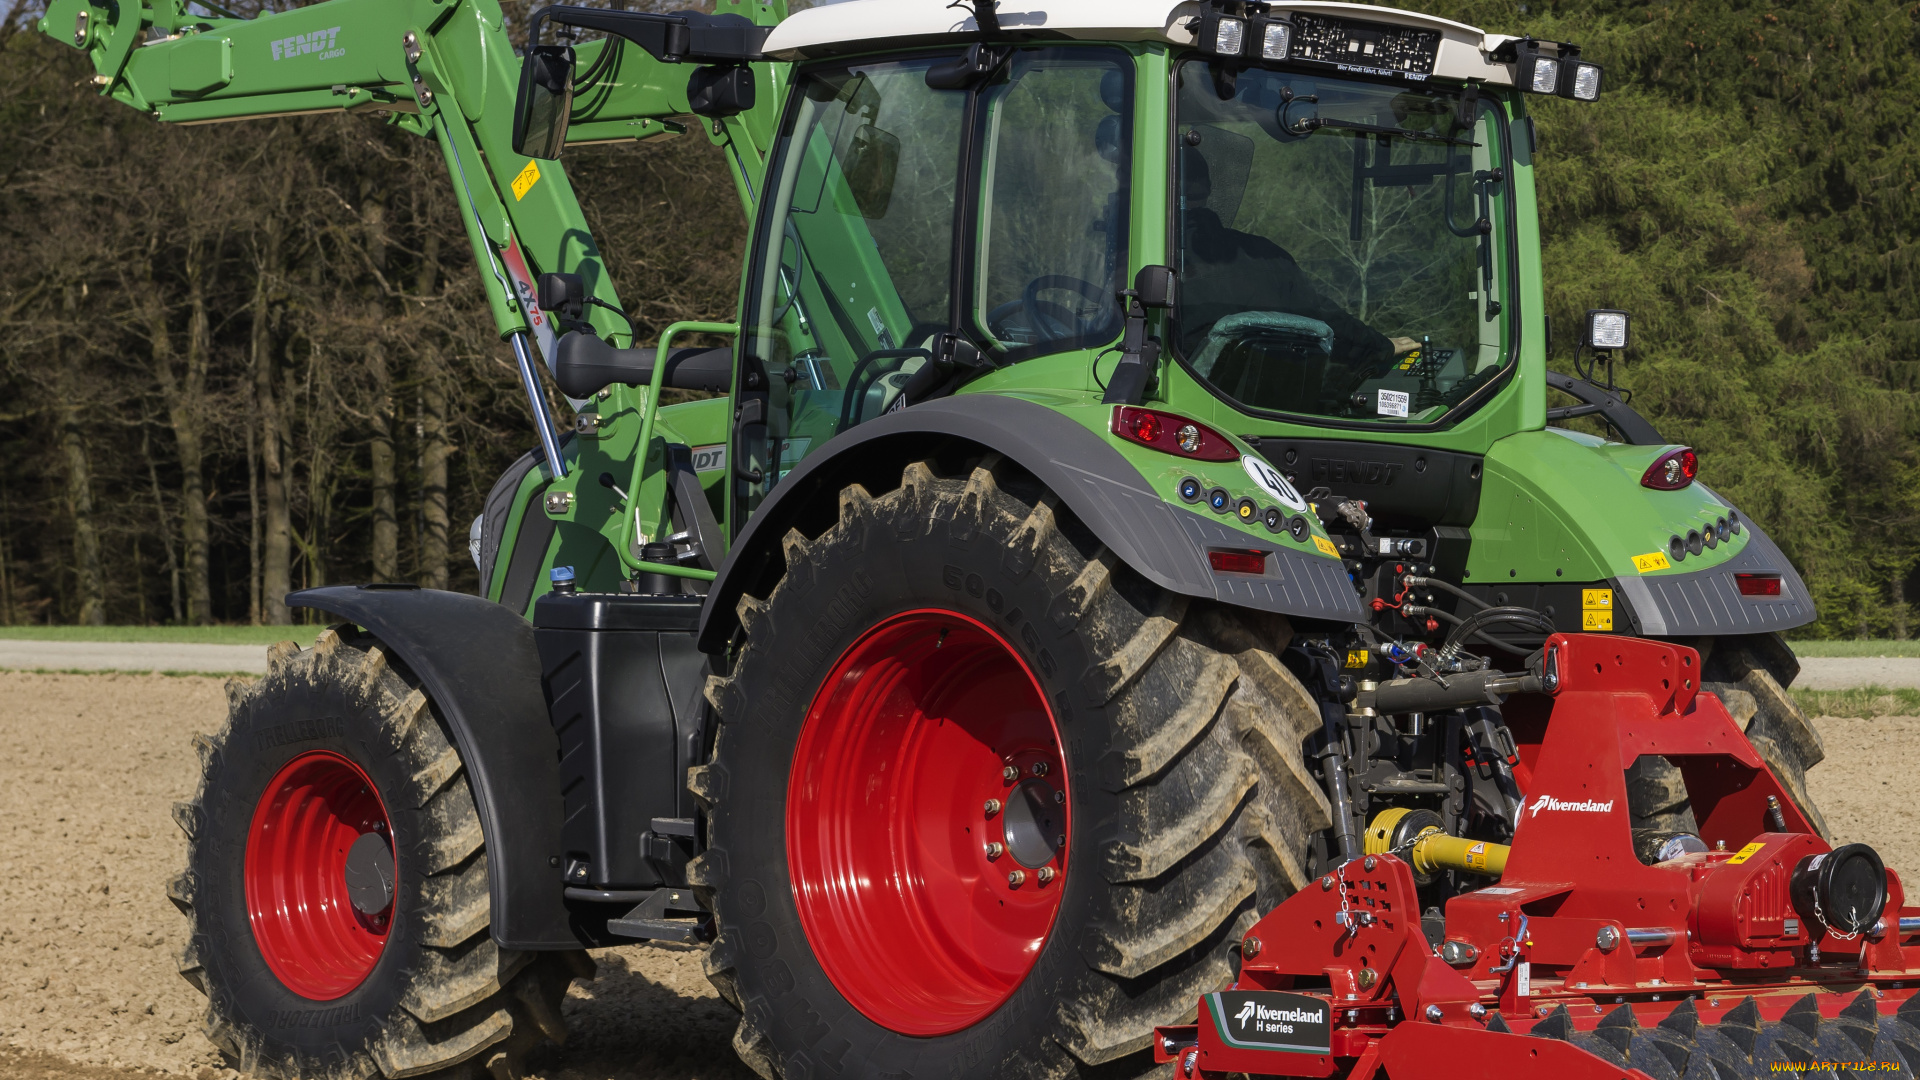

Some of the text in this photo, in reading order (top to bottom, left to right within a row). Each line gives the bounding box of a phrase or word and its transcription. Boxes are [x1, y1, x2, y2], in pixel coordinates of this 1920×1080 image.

[270, 26, 341, 61] FENDT
[319, 47, 346, 61] CARGO
[1348, 65, 1363, 74] Fendt
[1404, 72, 1428, 82] FENDT
[1311, 457, 1404, 487] FENDT
[1252, 462, 1299, 503] 40
[256, 716, 345, 752] TRELLEBORG
[1547, 798, 1614, 813] Kverneland
[736, 878, 853, 1076] TM800
[1256, 1004, 1323, 1024] Kverneland
[1256, 1020, 1294, 1034] H series
